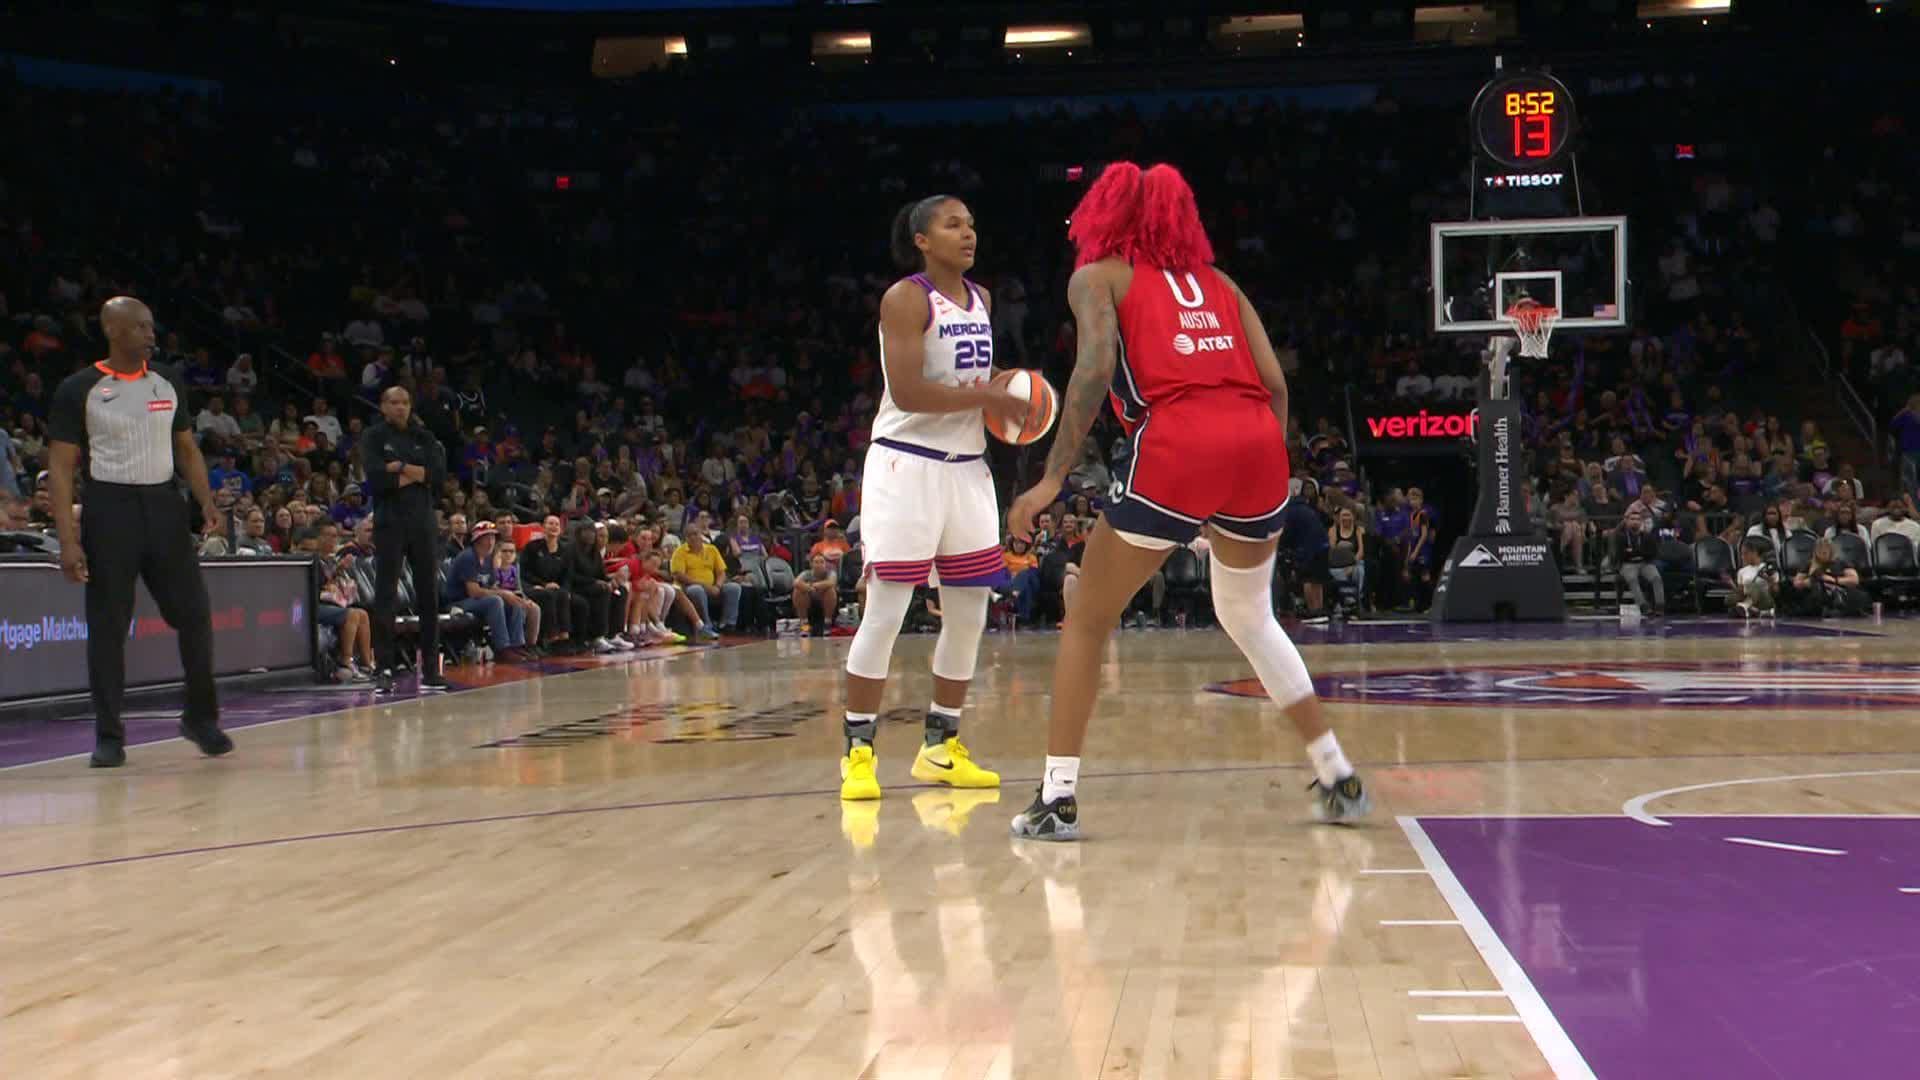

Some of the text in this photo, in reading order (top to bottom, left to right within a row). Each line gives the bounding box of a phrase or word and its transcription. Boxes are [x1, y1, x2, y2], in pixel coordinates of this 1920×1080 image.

[1505, 92, 1555, 116] 8:52
[1513, 115, 1550, 157] 13
[1506, 174, 1563, 187] TISSOT
[1178, 311, 1220, 329] AUSTIN
[1197, 335, 1234, 352] AT&T
[955, 340, 991, 369] 25
[1494, 416, 1510, 517] Banner Health
[1498, 544, 1547, 555] MOUNTAIN
[1502, 553, 1544, 562] AMERICA
[43, 615, 89, 641] Matchu
